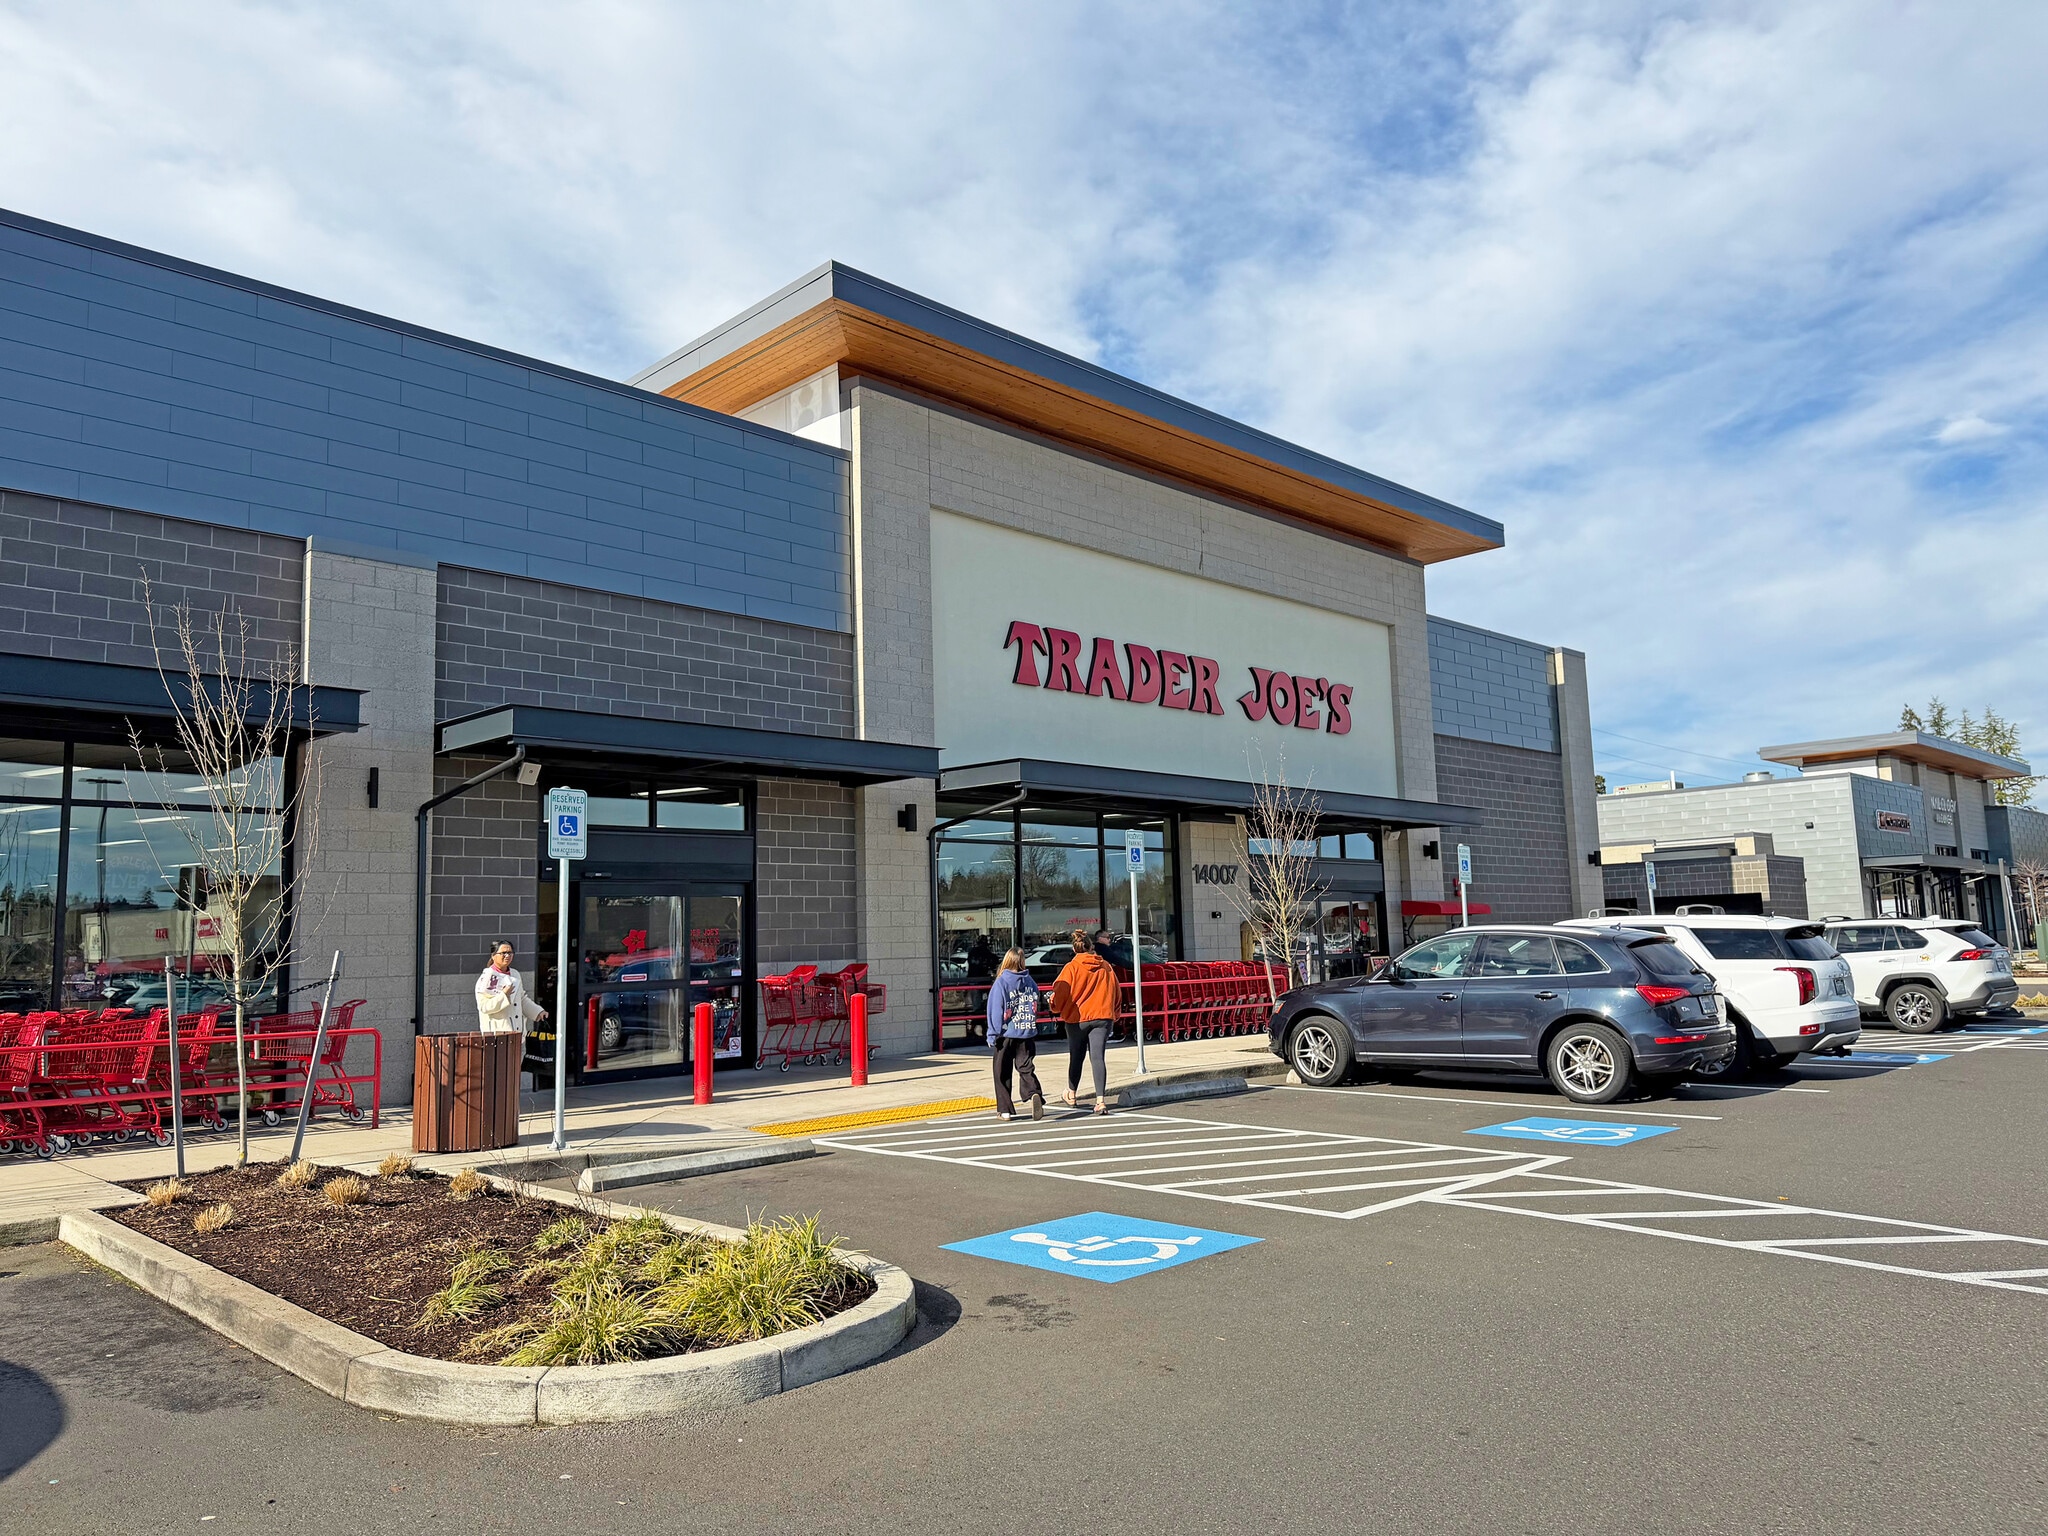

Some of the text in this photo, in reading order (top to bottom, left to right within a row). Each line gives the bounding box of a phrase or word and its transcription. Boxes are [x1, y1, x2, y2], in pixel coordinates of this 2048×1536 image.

[1003, 620, 1353, 735] TRADER JOE'S
[552, 794, 585, 804] RESERVED
[554, 804, 582, 814] PARKING
[1191, 863, 1239, 885] 14007
[1013, 1005, 1030, 1013] ARE
[1014, 1022, 1037, 1030] HERE
